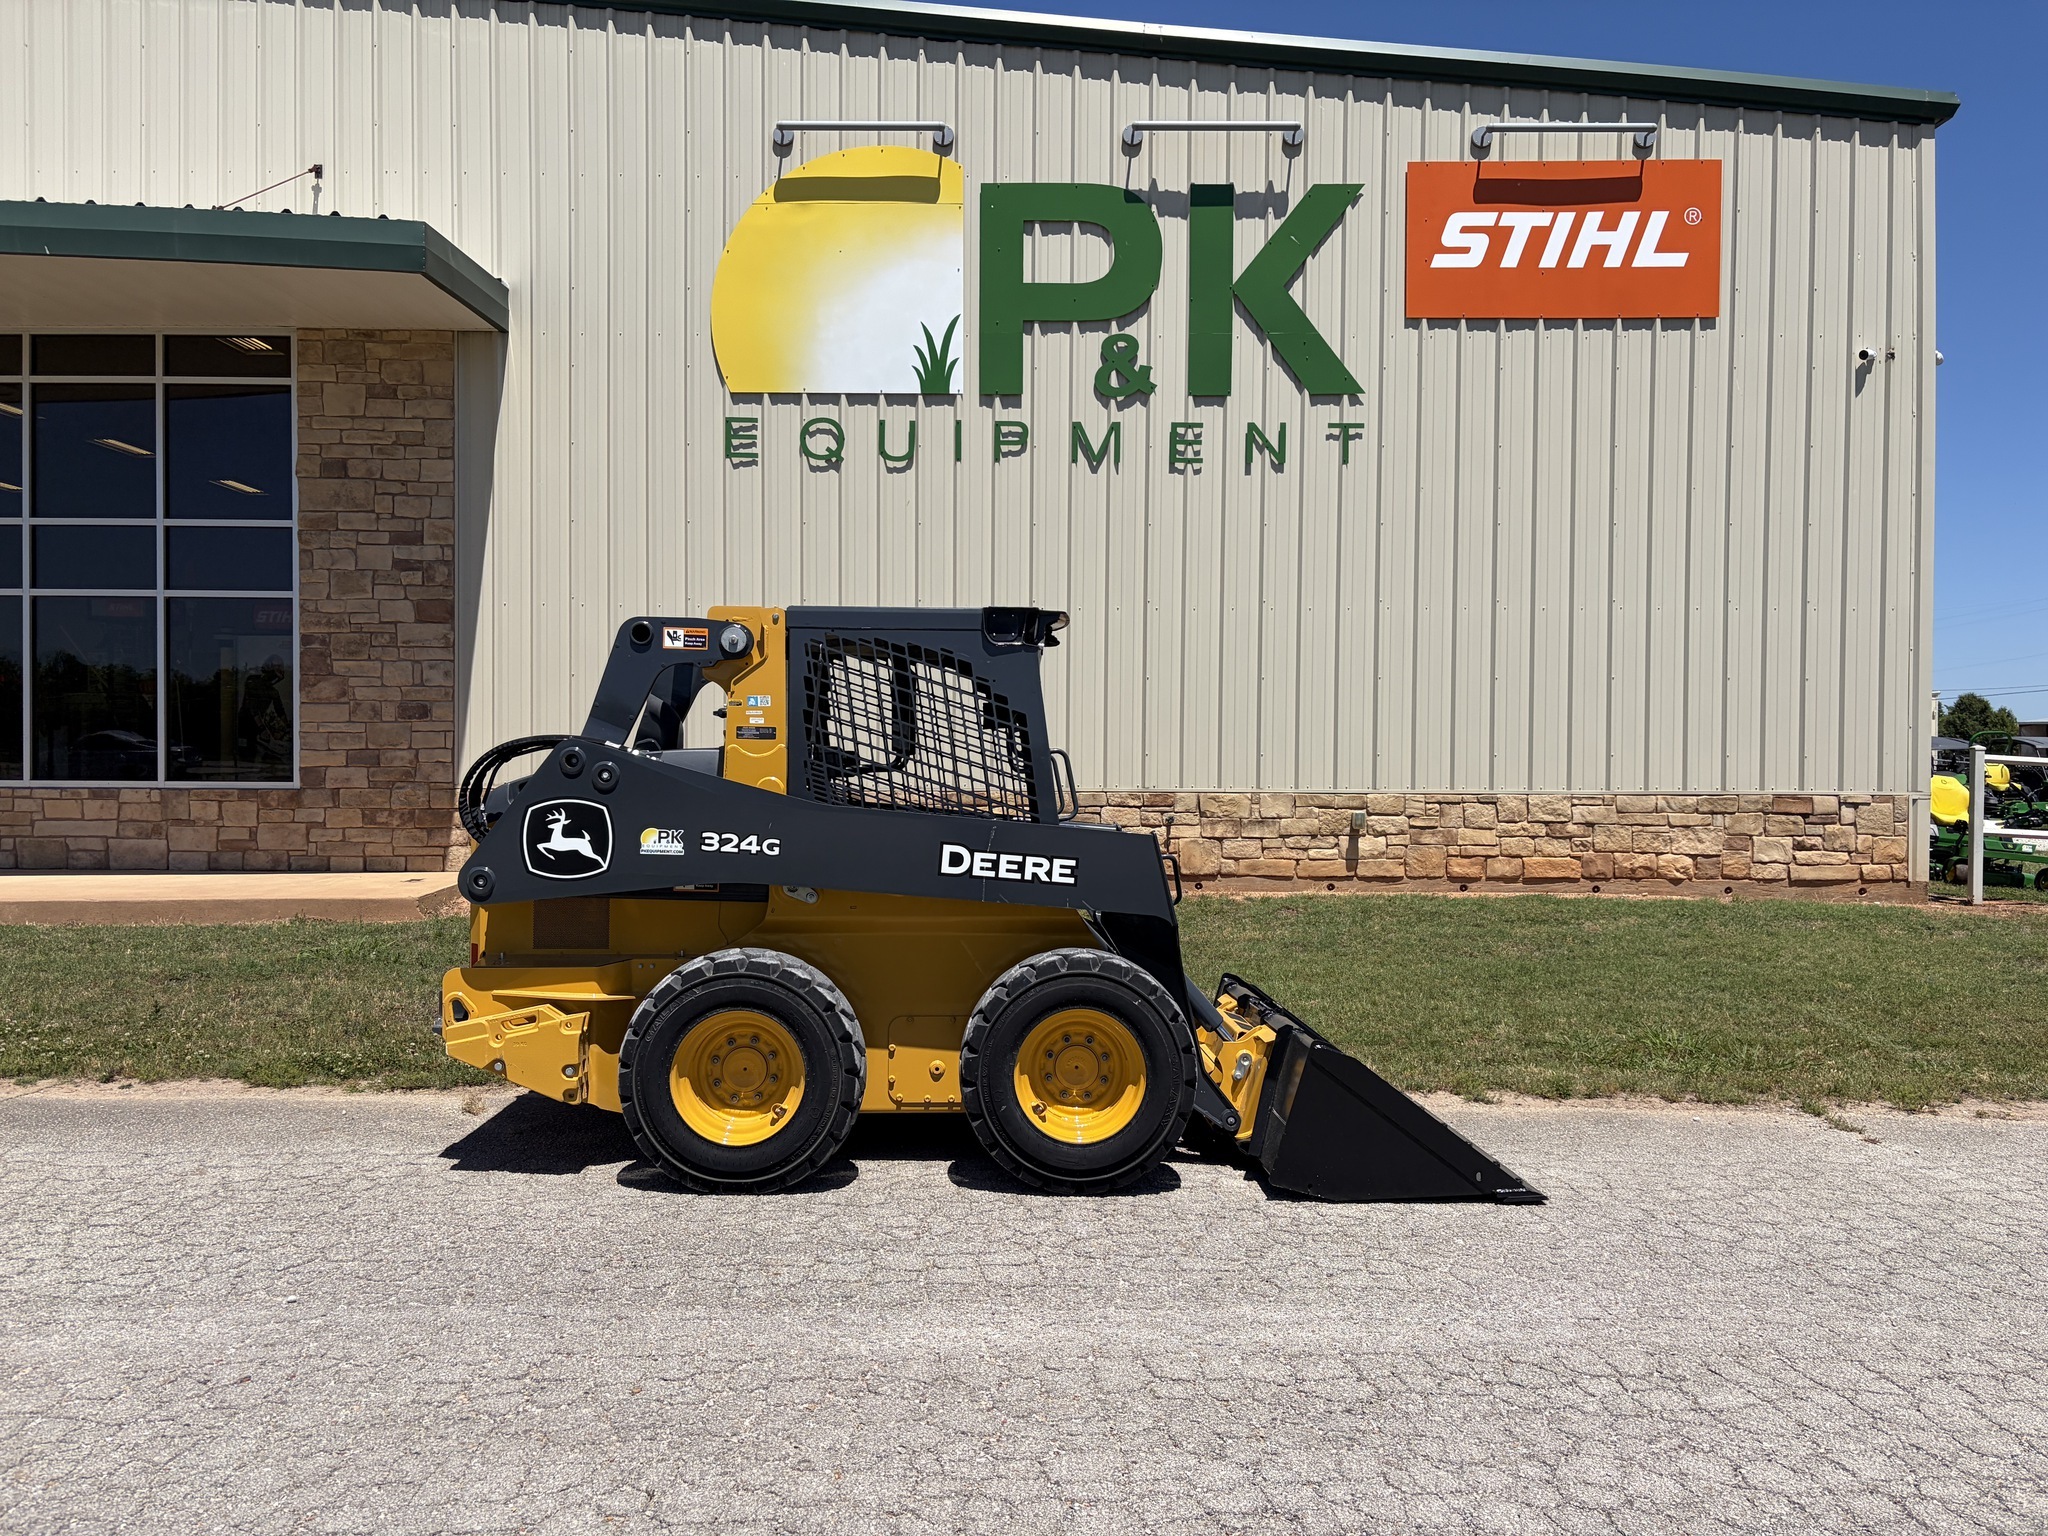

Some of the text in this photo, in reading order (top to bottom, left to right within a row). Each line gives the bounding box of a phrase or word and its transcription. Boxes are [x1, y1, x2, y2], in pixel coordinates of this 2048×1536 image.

[1429, 210, 1690, 268] STIHL
[979, 183, 1366, 397] P&K
[725, 416, 1365, 465] EQUIPMENT
[701, 832, 781, 856] 324G
[940, 843, 1077, 884] DEERE
